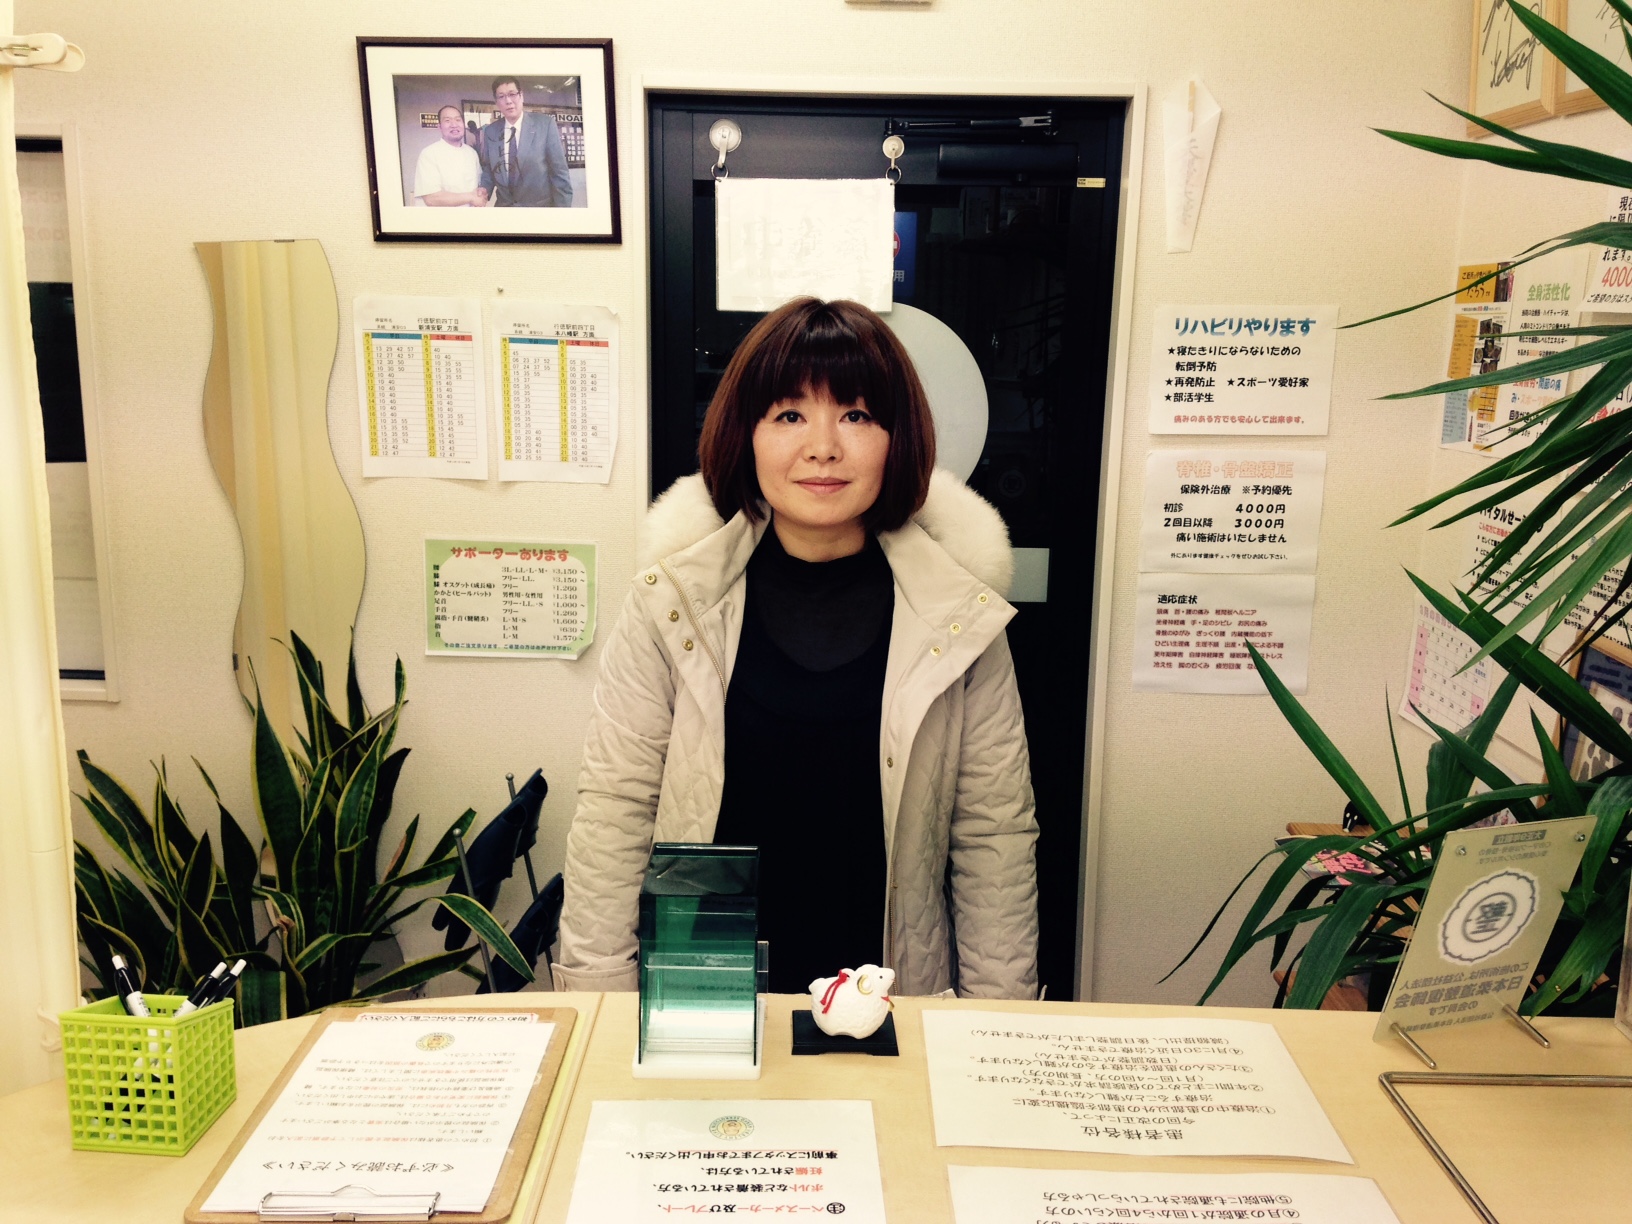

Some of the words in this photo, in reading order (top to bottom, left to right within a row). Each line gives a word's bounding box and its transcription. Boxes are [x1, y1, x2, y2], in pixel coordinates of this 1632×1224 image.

[1175, 317, 1316, 337] リハビリやります
[1177, 346, 1301, 356] 寝たきりにならないための
[1175, 361, 1217, 372] 転倒予防
[1174, 377, 1216, 388] 再発防止
[1237, 377, 1310, 388] スポーツ愛好家
[1173, 393, 1214, 403] 部活学生
[1176, 460, 1294, 478] 脊椎・骨盤矯正
[1180, 485, 1231, 495] 保険外治療
[1164, 503, 1183, 512] 初診
[1176, 532, 1287, 543] 痛い施術はいたしません
[451, 547, 569, 561] サポーターあります
[1158, 594, 1198, 604] 適応症状
[1080, 1126, 1182, 1140] 患者様各位
[699, 1167, 822, 1176] 妊娠されている方は、
